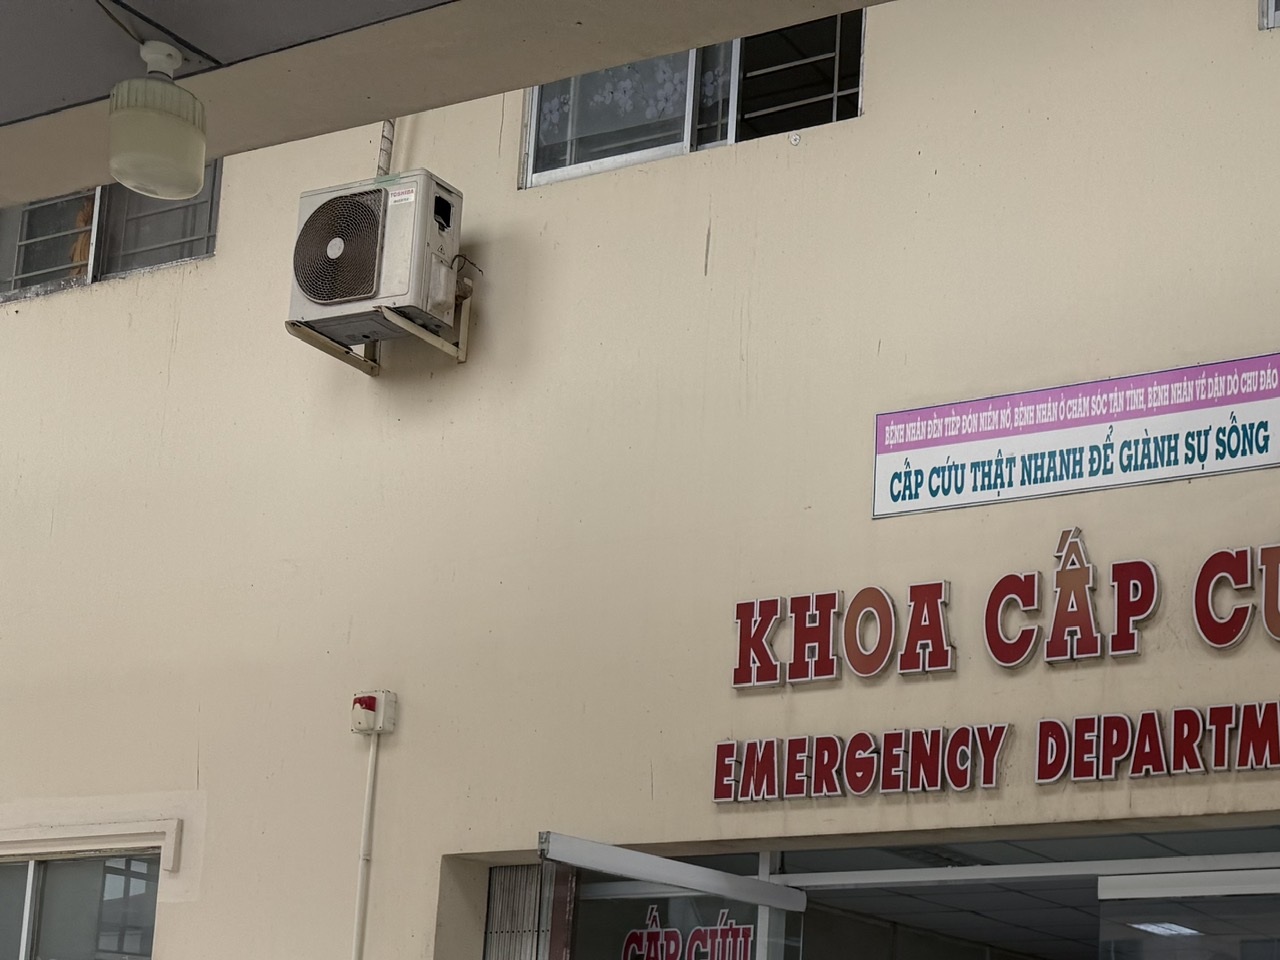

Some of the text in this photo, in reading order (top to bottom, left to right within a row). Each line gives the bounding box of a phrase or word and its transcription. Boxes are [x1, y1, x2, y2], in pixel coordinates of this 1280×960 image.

[1171, 377, 1194, 404] NHÂN
[1240, 372, 1258, 393] CHU
[1260, 363, 1278, 390] ĐÁO
[890, 411, 1270, 502] CẤP CỨU THẬT NHANH ĐỂ GIÀNH SỰ SỐNG
[732, 580, 955, 688] KHOA
[984, 527, 1159, 669] CẤP
[713, 724, 1010, 802] EMERGENCY
